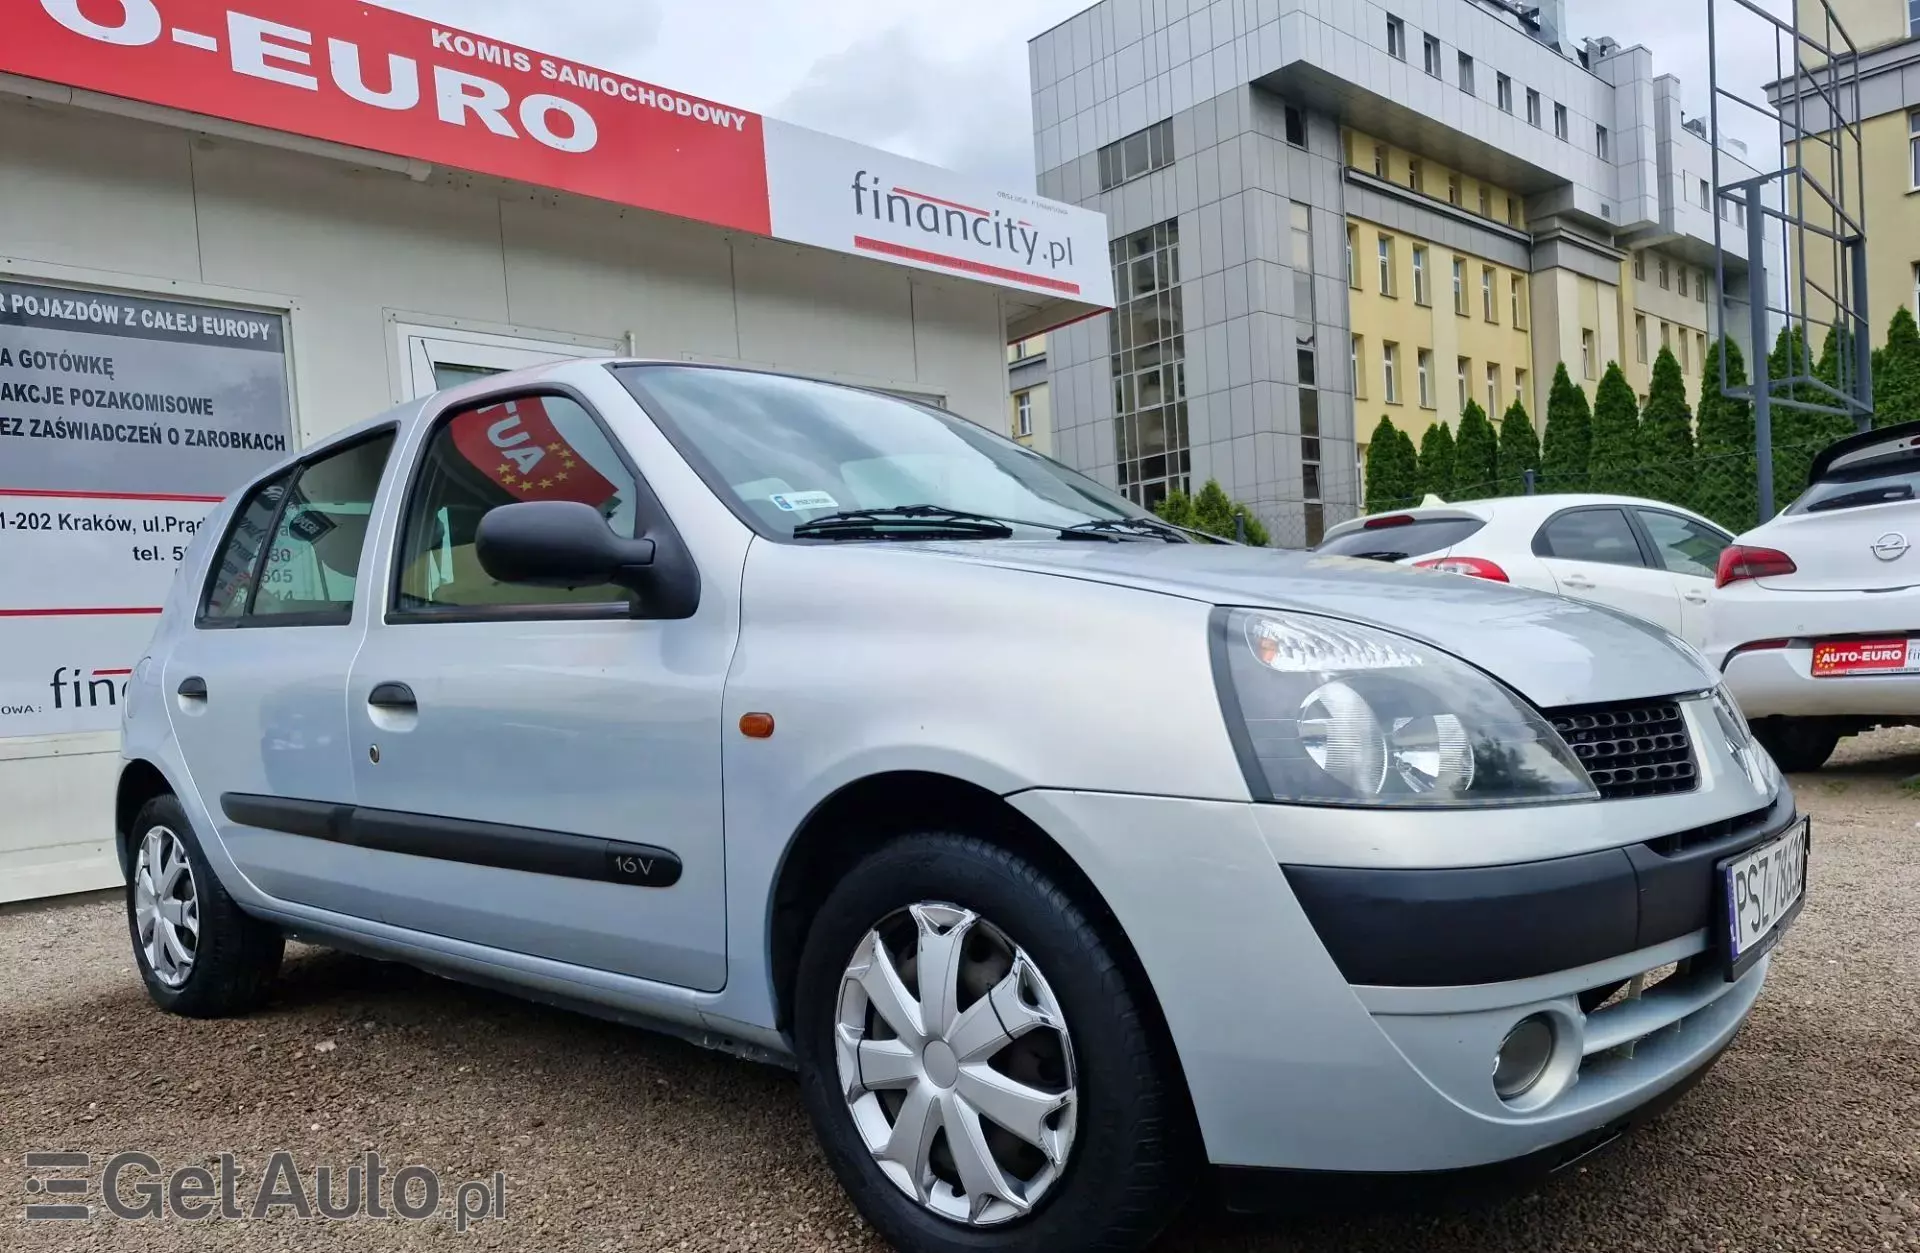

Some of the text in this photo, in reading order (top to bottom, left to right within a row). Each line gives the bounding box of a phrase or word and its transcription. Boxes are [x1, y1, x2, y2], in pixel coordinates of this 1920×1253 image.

[431, 27, 746, 131] KOMIS SAMOCHODOWY
[851, 170, 1074, 268] financity.pl
[11, 294, 118, 325] POJAZDÓW
[124, 307, 137, 326] Z
[141, 309, 198, 333] CAŁEJ
[202, 316, 270, 341] EUROPY
[0, 347, 115, 381] A GOTÓWKĘ
[1, 382, 214, 416] AKCJE POZAKOMISOWE
[30, 416, 162, 445] ZAŚWIADCZEŃ
[168, 430, 180, 446] O
[184, 431, 286, 452] ZAROBKACH
[58, 513, 137, 535] Kraków,
[132, 546, 165, 561] tel.
[1821, 650, 1903, 663] AUTO-EURO
[50, 666, 128, 709] fin
[615, 855, 654, 876] 16V
[1735, 856, 1769, 944] PSZ
